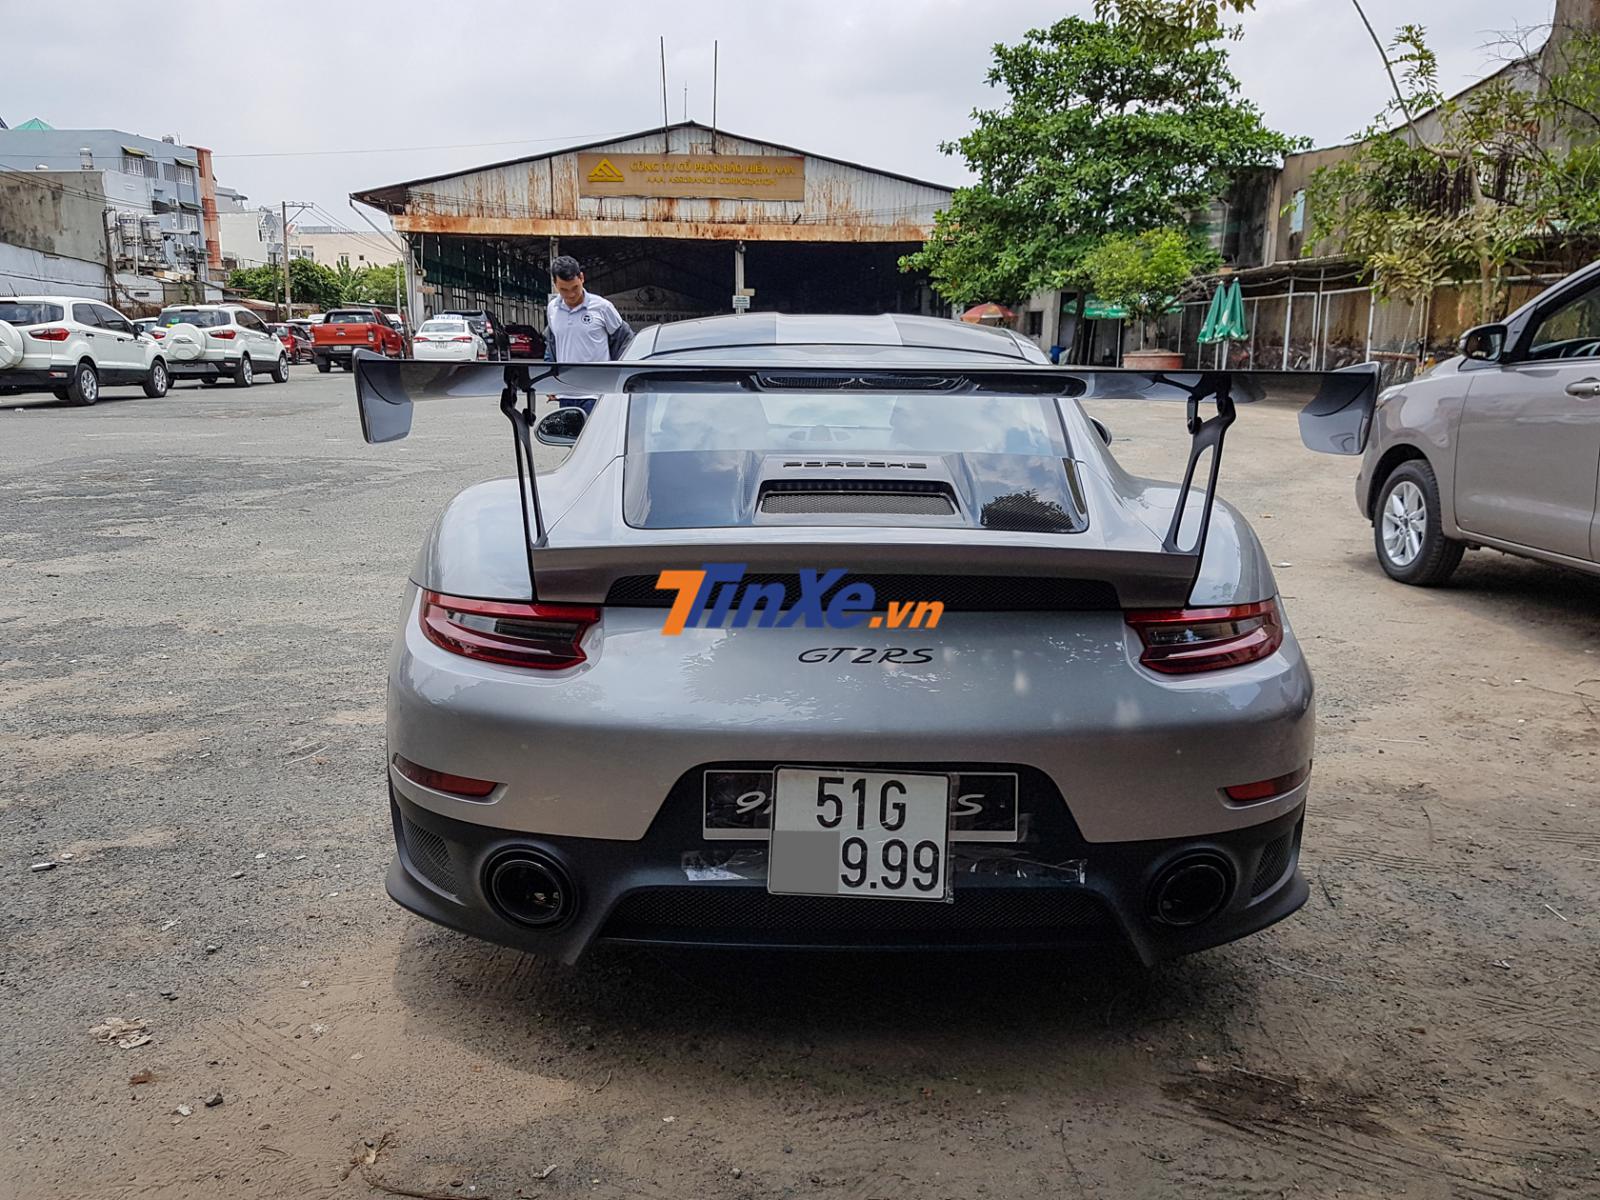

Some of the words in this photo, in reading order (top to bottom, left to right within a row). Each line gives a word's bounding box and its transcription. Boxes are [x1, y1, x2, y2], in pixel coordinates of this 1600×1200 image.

[631, 160, 659, 172] CÔNG
[816, 776, 907, 832] 51G
[841, 836, 940, 892] 9.99
